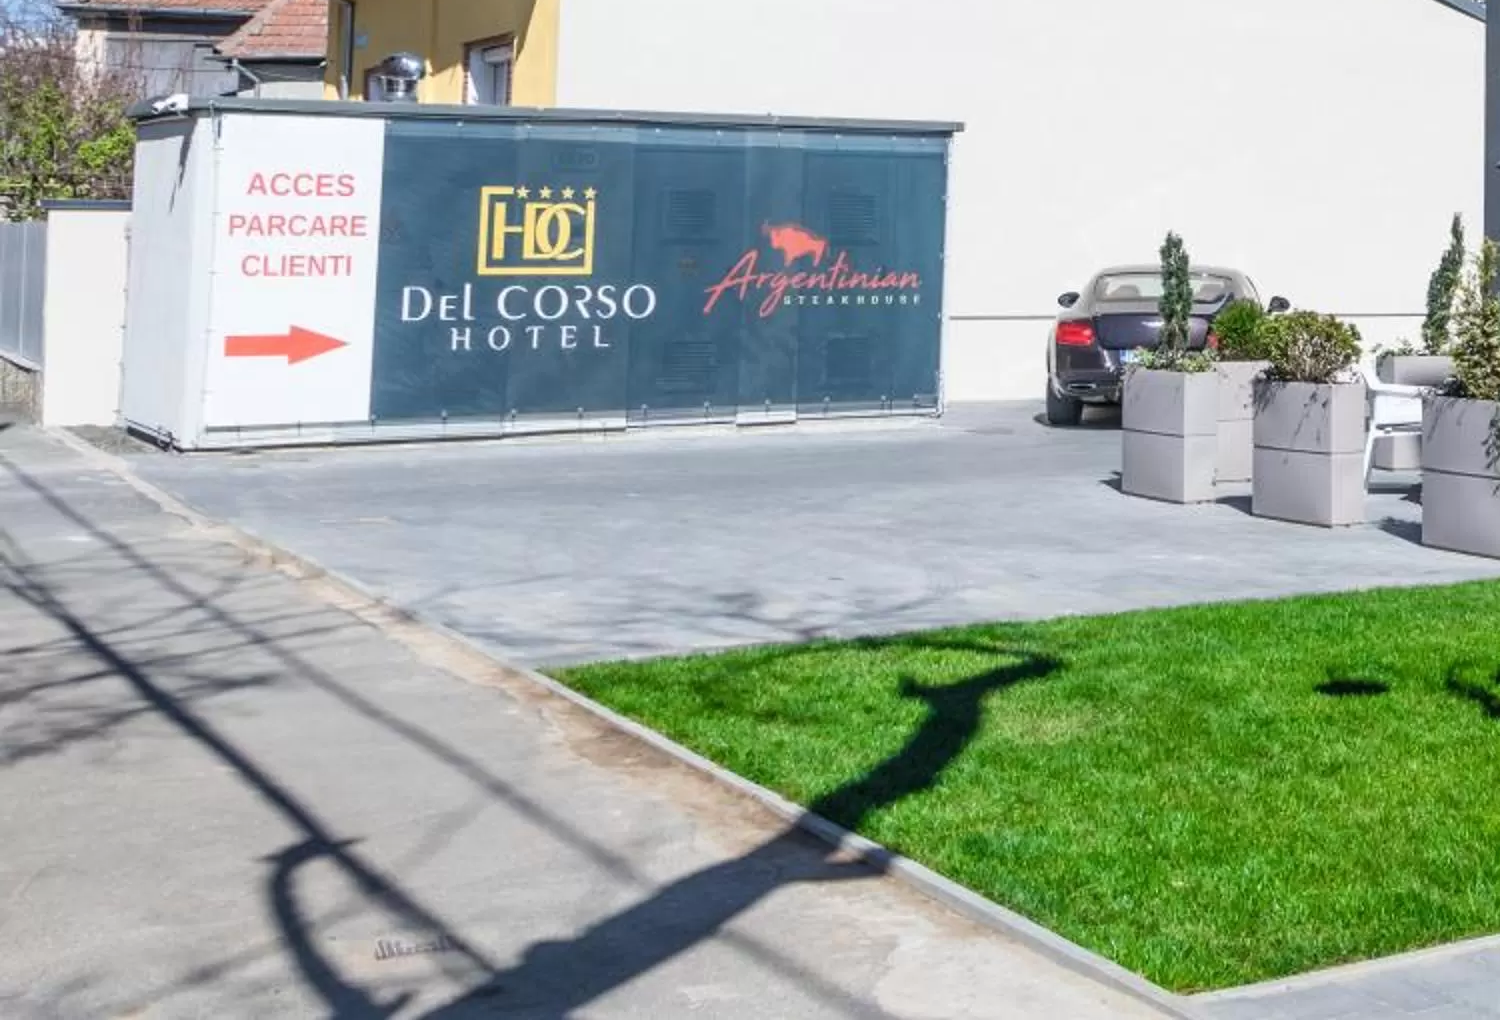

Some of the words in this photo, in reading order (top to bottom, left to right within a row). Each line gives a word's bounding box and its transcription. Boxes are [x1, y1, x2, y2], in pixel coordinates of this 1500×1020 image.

[246, 172, 355, 197] ACCES
[228, 214, 368, 237] PARCARE
[240, 254, 352, 277] CLIENTI
[703, 249, 920, 318] Argentinian
[497, 283, 656, 320] CORSO
[783, 294, 921, 305] STEAKHOUSE
[451, 325, 609, 351] HOTEL
